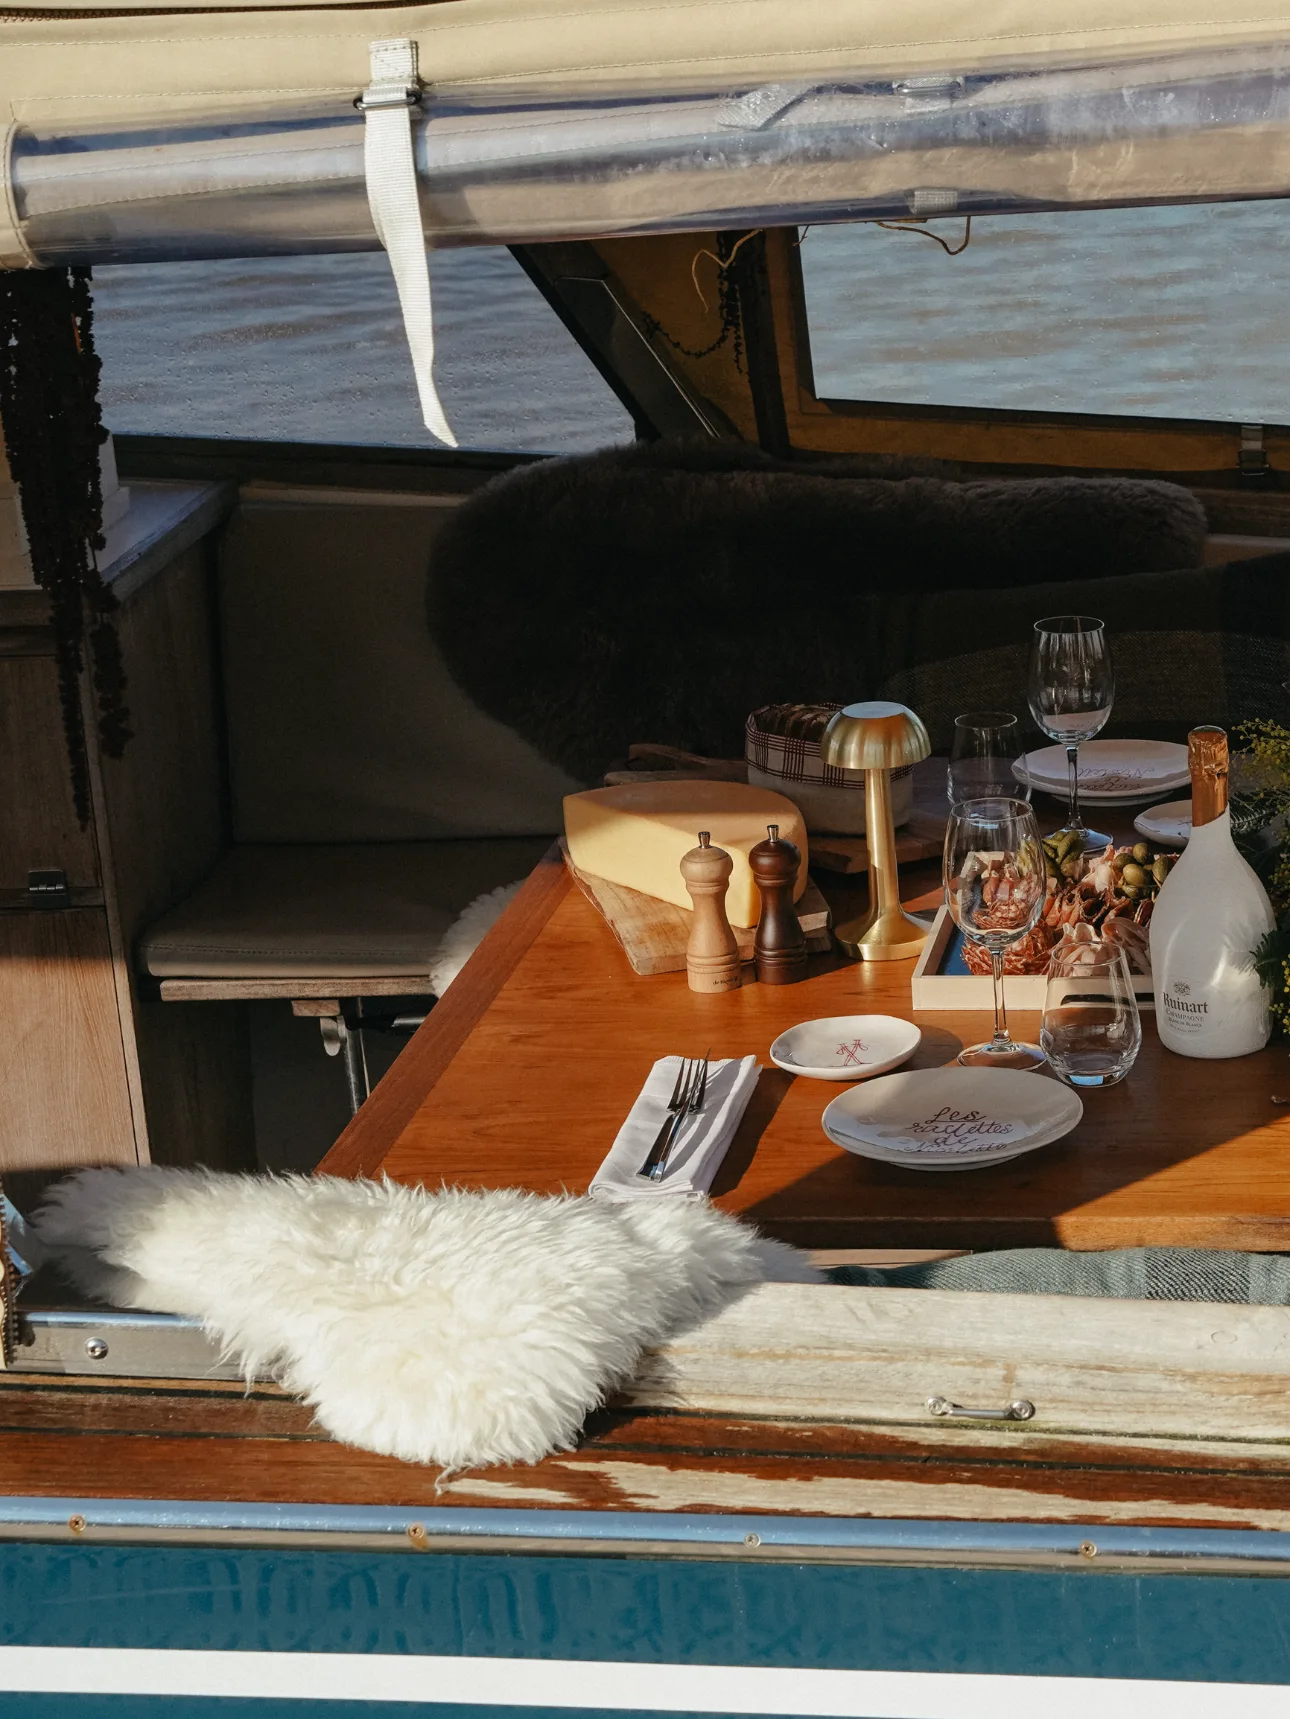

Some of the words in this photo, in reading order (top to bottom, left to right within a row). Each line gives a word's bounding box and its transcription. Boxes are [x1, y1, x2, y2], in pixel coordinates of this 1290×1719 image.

[1163, 992, 1208, 1013] Ruinart
[925, 1107, 986, 1124] Les
[905, 1121, 1014, 1137] raclettes
[934, 1134, 977, 1146] de
